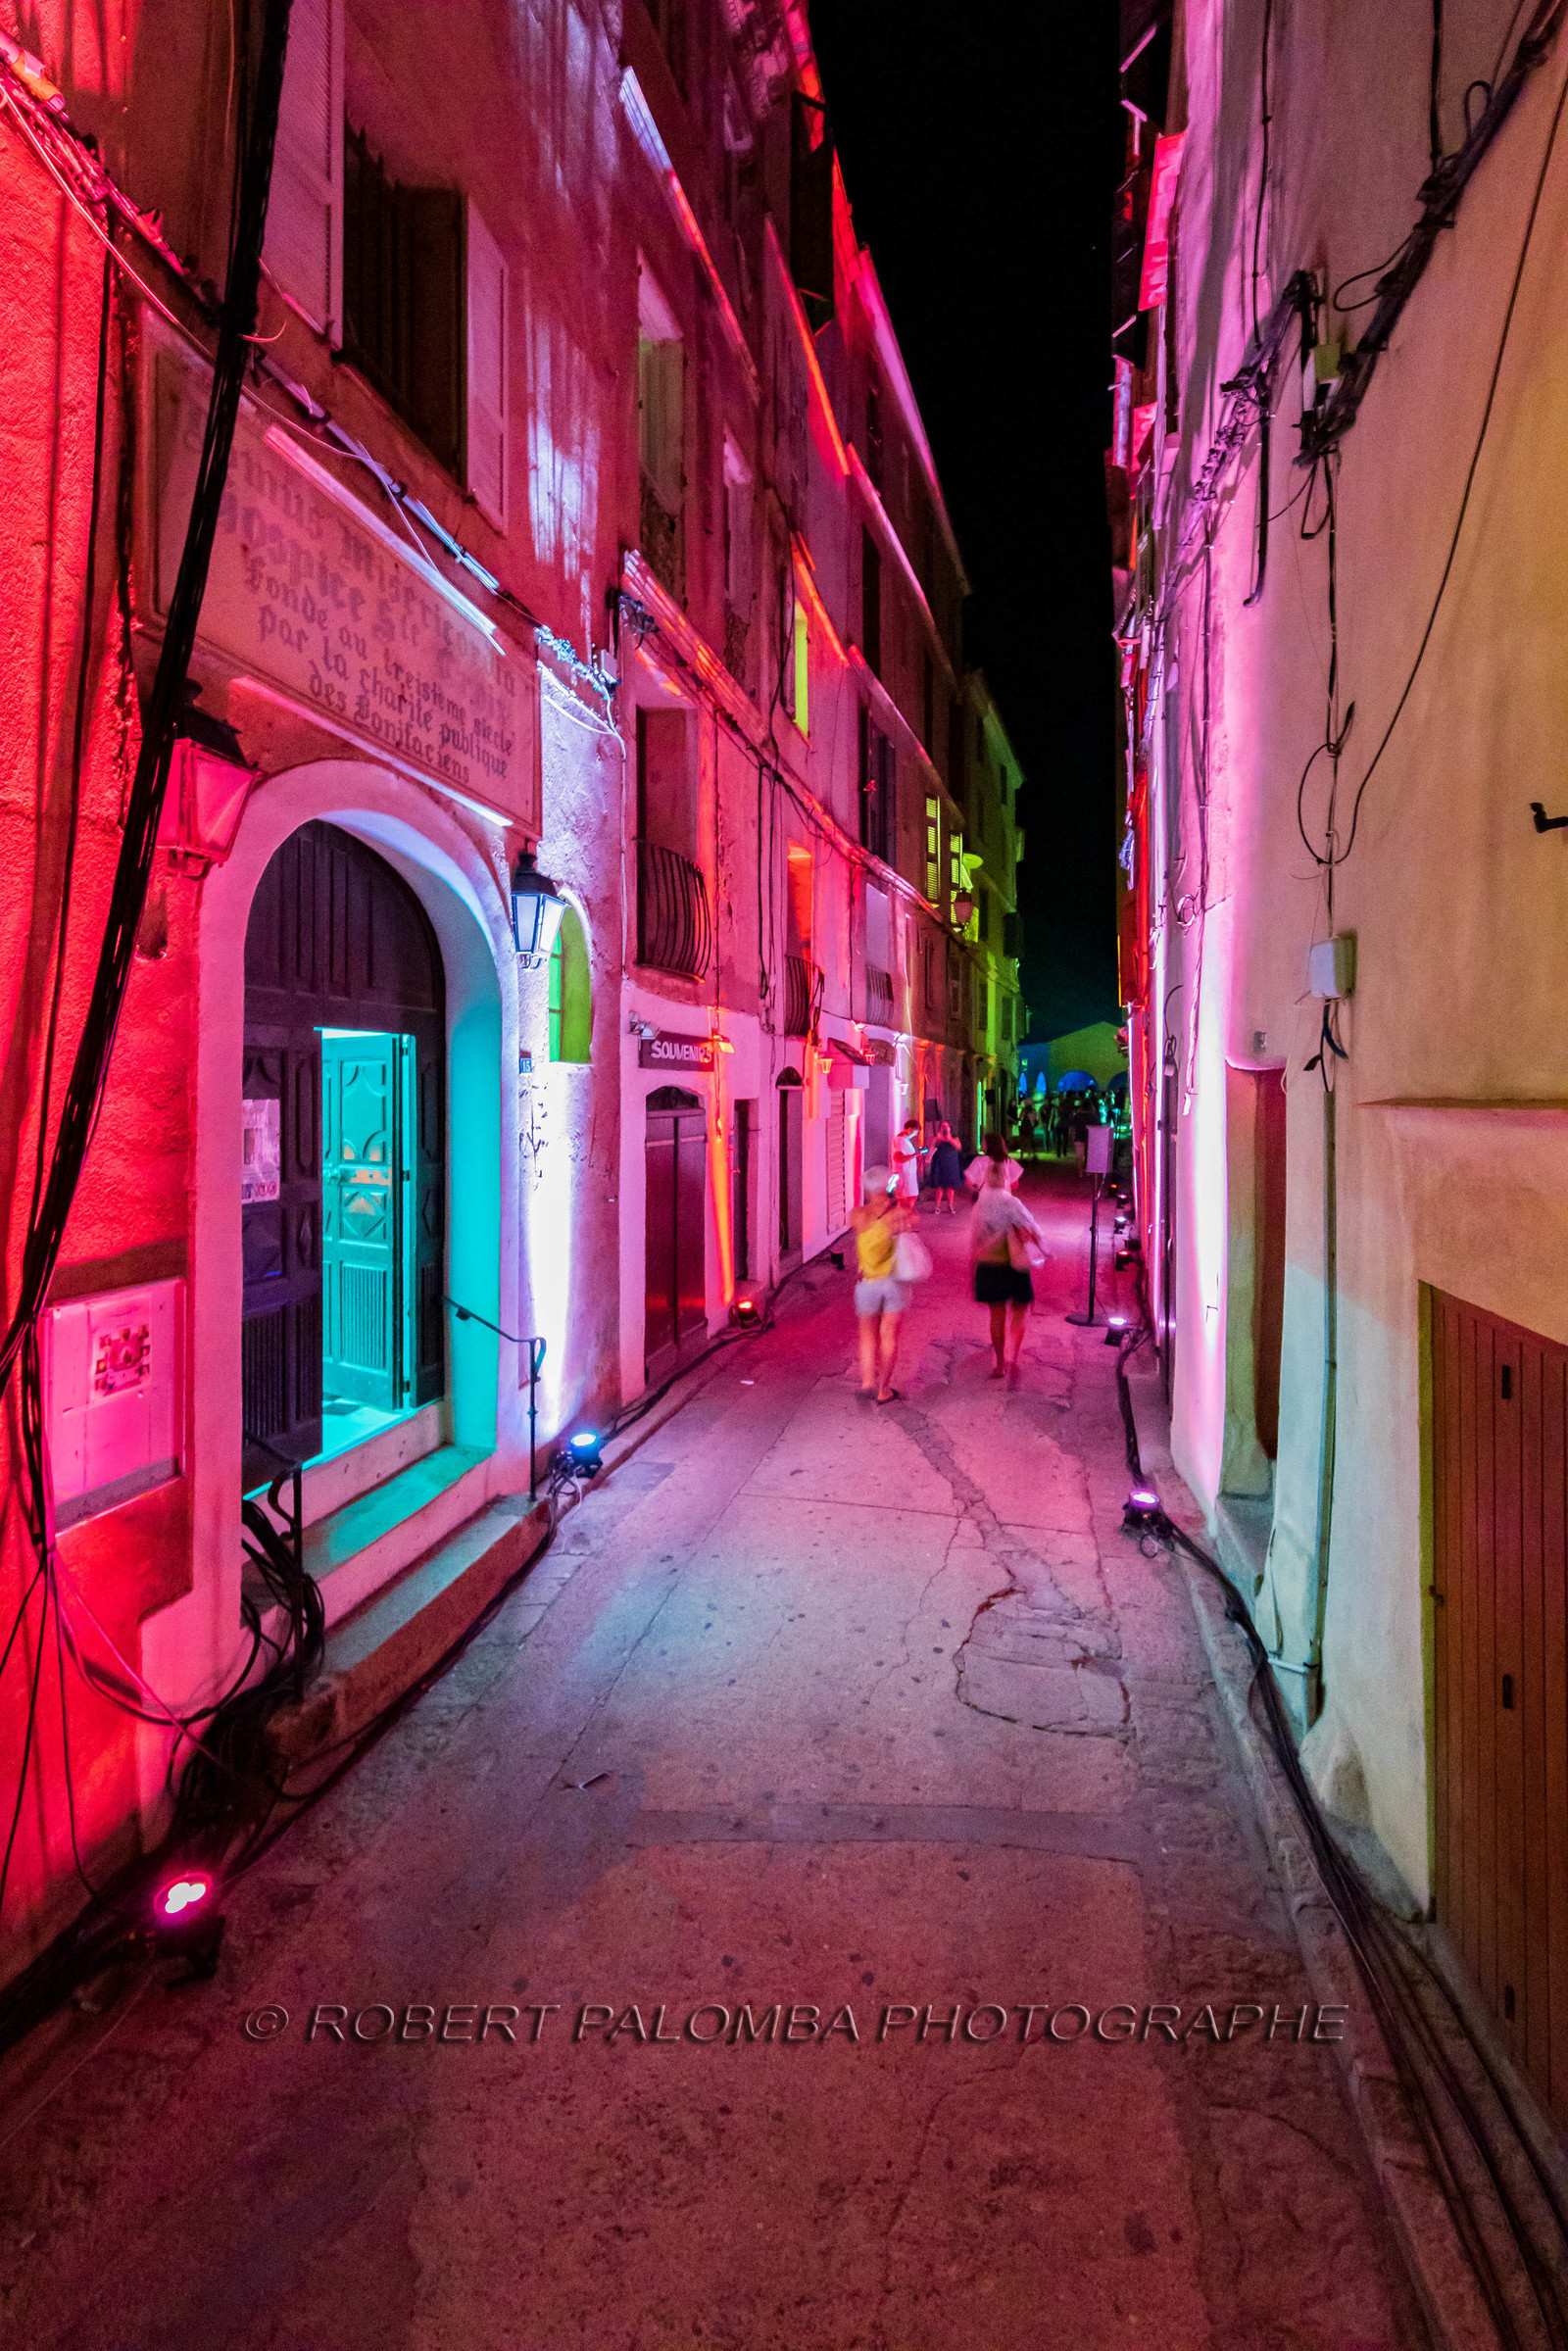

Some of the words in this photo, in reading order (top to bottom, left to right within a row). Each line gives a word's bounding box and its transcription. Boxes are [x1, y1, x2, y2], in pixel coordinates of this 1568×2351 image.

[338, 625, 368, 661] au
[258, 604, 309, 655] par
[322, 635, 349, 681] la
[439, 722, 508, 781] publique
[308, 660, 346, 712] des
[354, 692, 469, 784] Bonifaciens
[651, 1041, 712, 1062] SOUVENIRS
